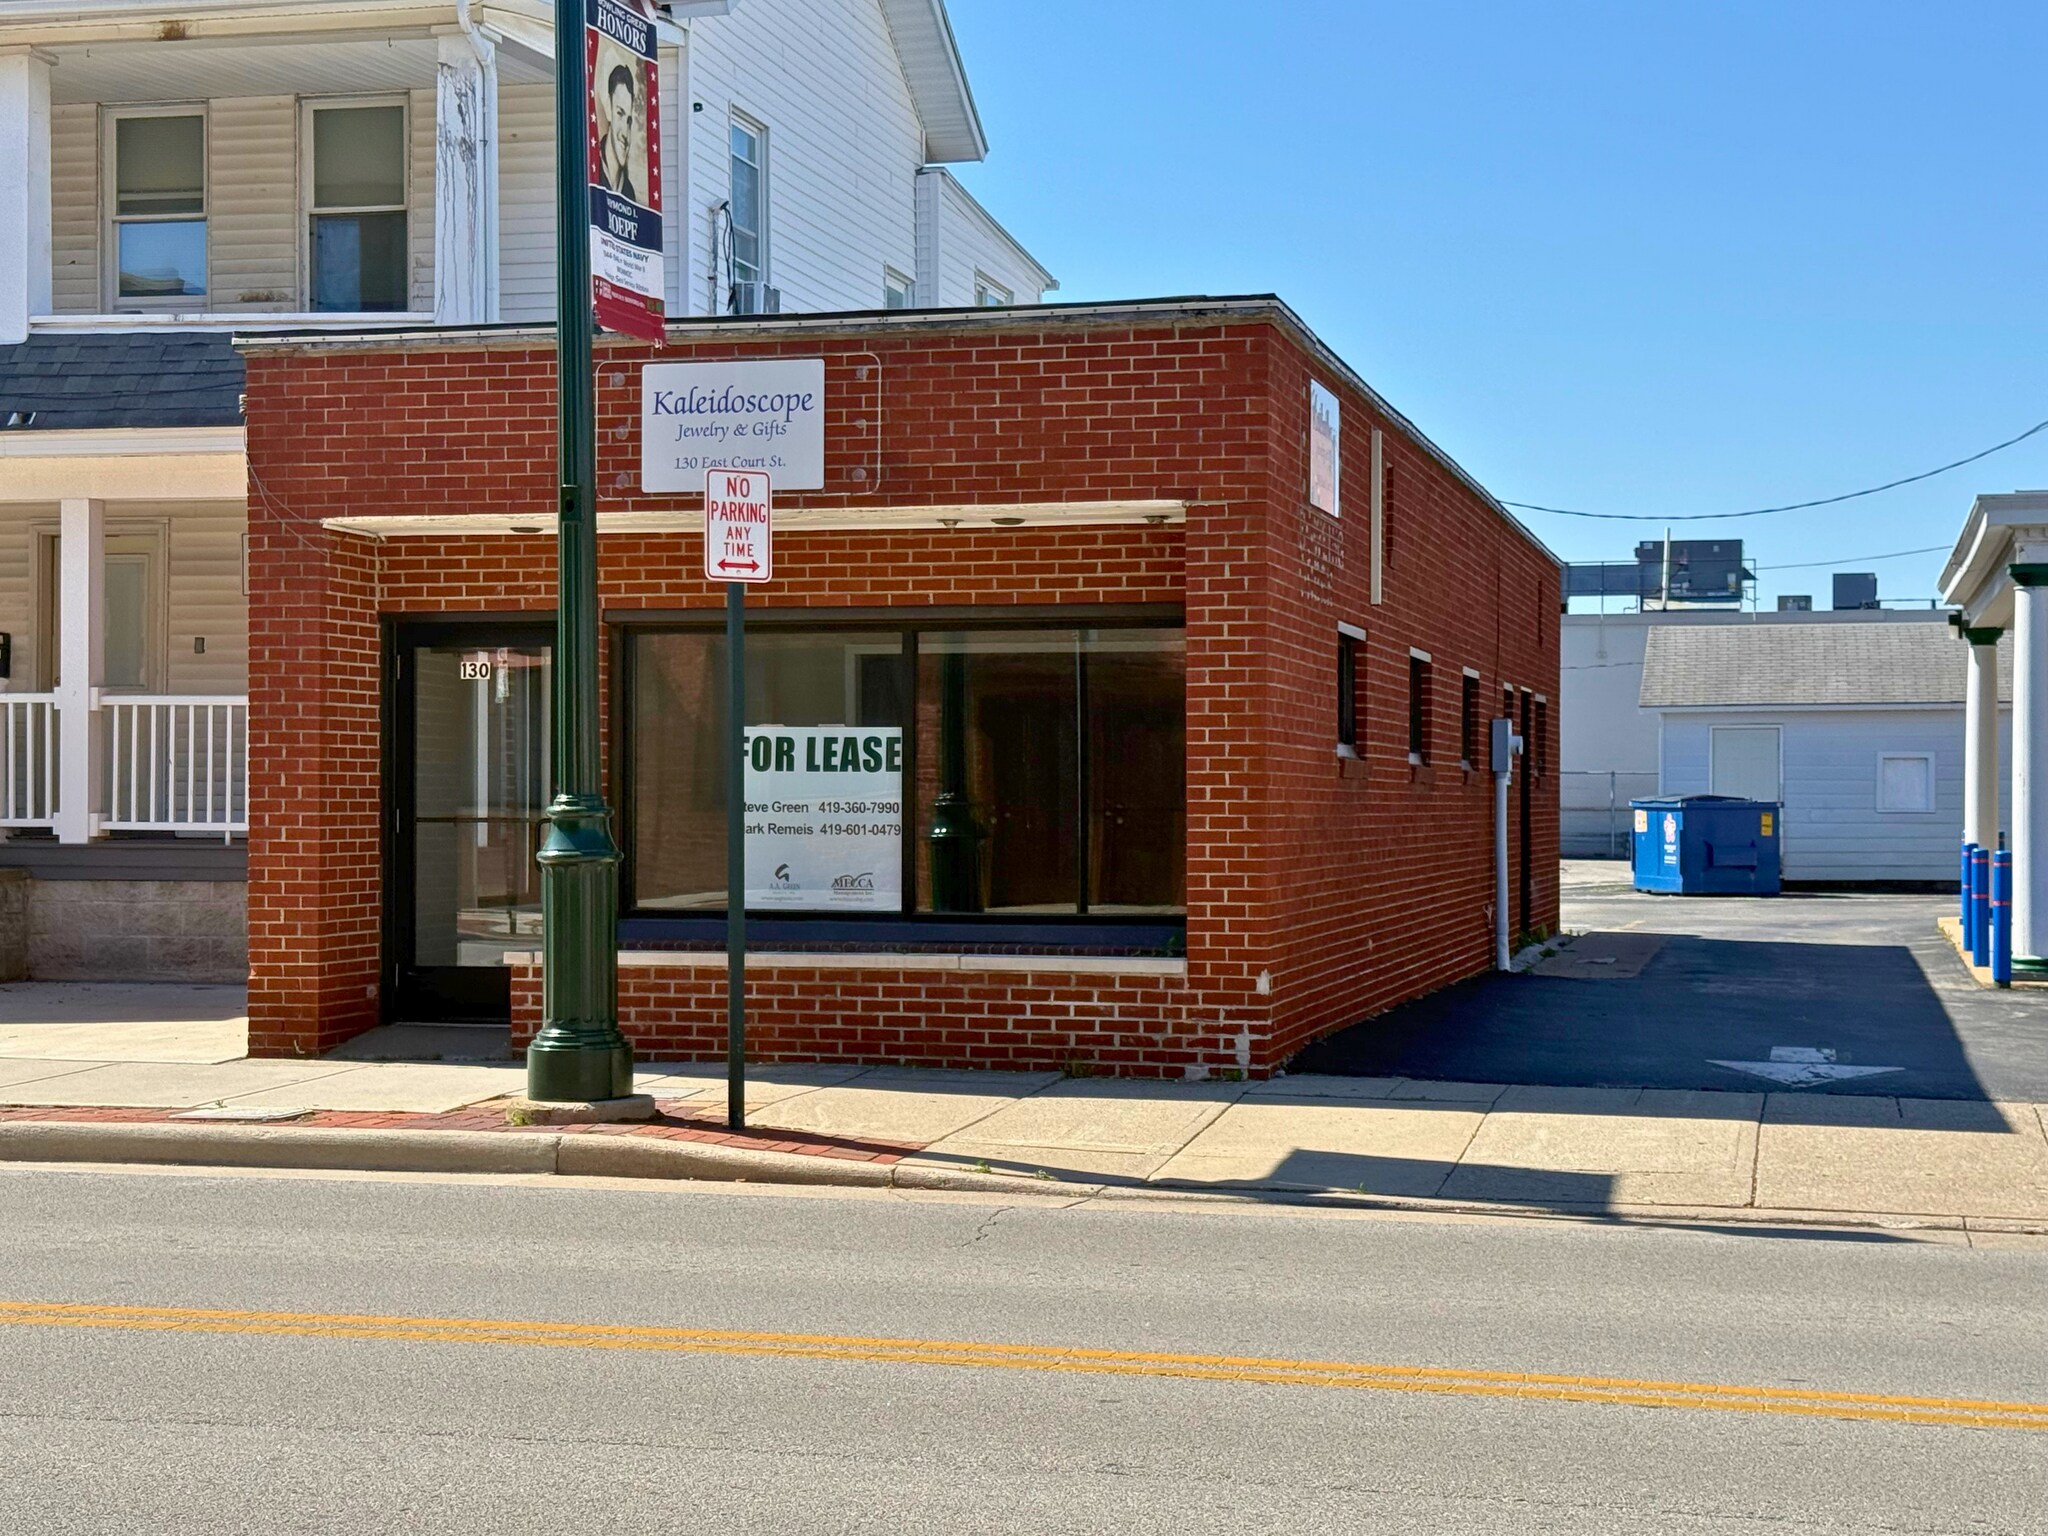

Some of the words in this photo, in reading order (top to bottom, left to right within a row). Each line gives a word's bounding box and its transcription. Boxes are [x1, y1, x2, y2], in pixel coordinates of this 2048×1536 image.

[597, 6, 646, 53] HONORS
[652, 385, 814, 423] Kaleidoscope
[675, 421, 729, 442] Jewelry
[733, 423, 748, 437] &
[752, 420, 787, 441] Gifts
[674, 456, 698, 470] 130
[702, 456, 727, 469] East
[731, 456, 766, 468] Court
[769, 455, 786, 467] St.
[726, 477, 750, 498] NO
[711, 500, 766, 523] PARKING
[726, 526, 751, 541] ANY
[724, 542, 754, 557] TIME
[462, 662, 489, 678] 130
[806, 736, 902, 773] LEASE
[744, 801, 769, 813] teve
[771, 801, 809, 813] Green
[818, 802, 900, 814] 419-360-7990
[744, 823, 764, 835] ark
[767, 823, 814, 835] Remeis
[819, 823, 901, 836] 419-601-0479
